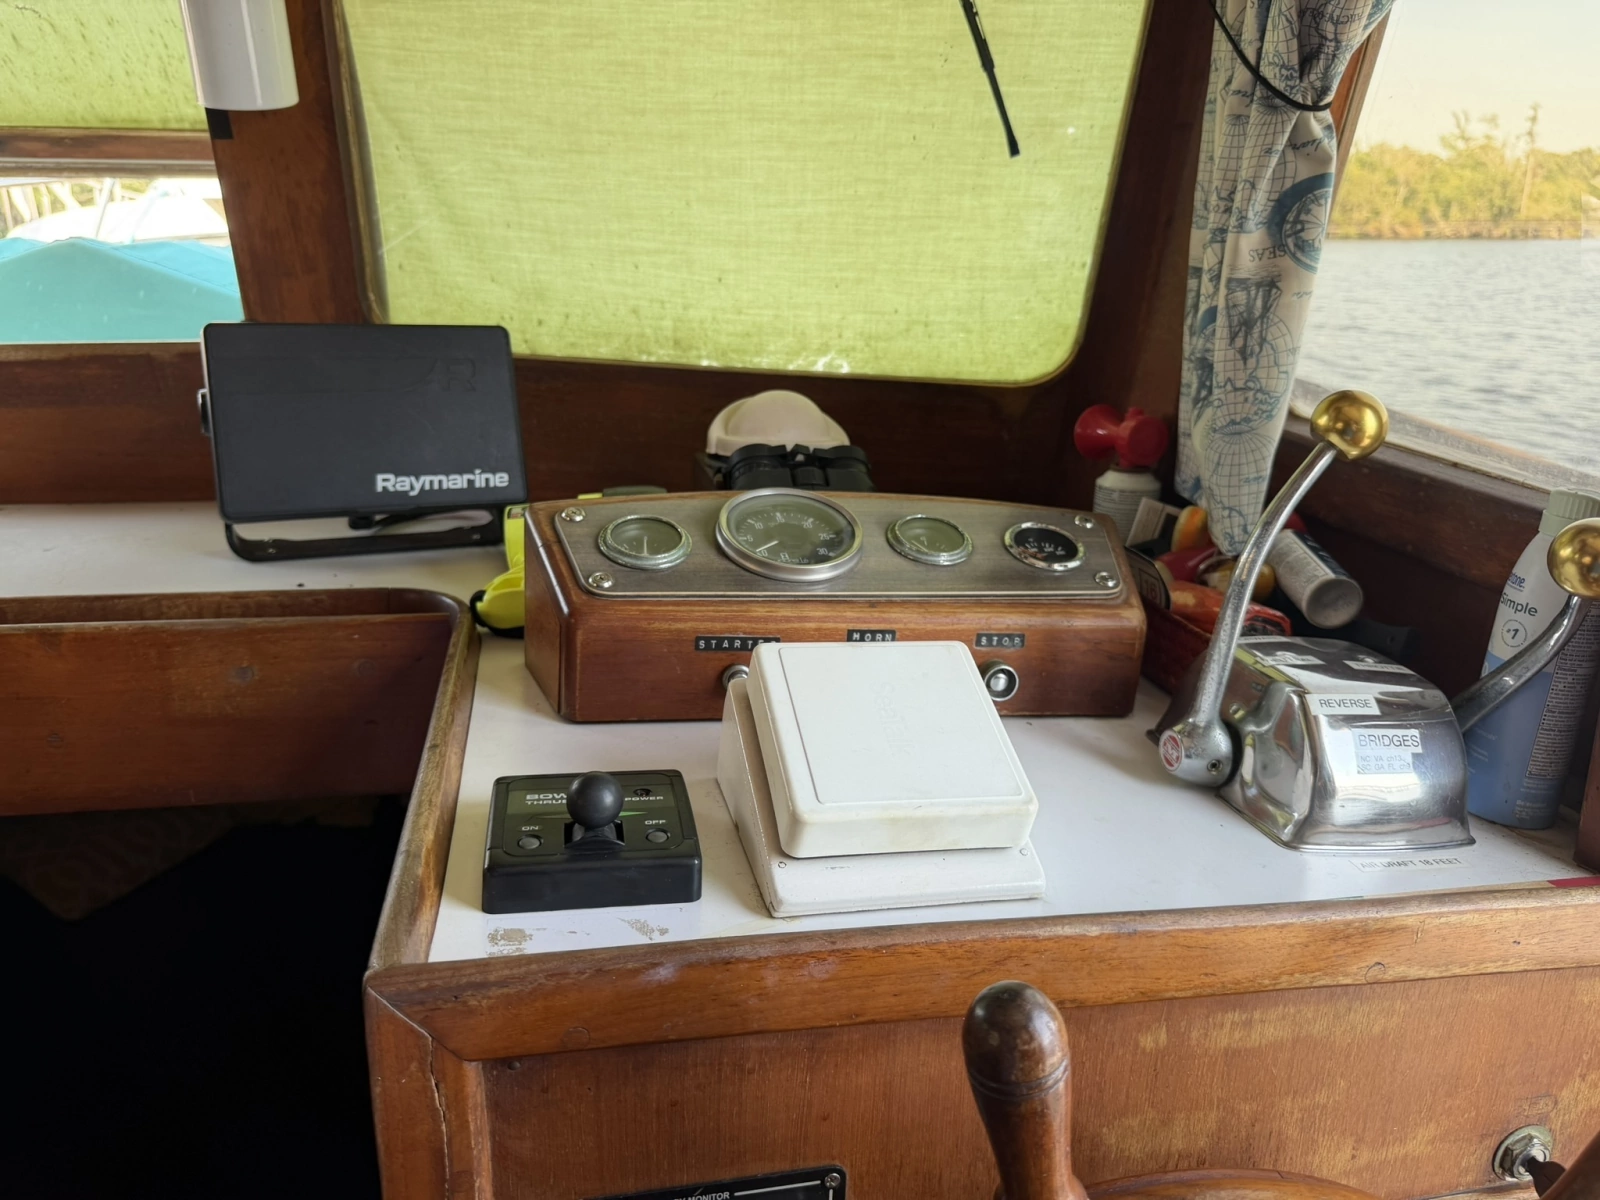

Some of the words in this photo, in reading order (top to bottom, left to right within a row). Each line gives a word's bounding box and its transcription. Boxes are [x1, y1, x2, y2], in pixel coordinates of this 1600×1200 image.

[1248, 244, 1286, 263] SEAS
[375, 469, 510, 496] Raymarine
[803, 521, 813, 529] 20
[1501, 592, 1538, 617] Simple
[853, 632, 893, 642] HORN
[980, 636, 1022, 646] STOP
[698, 639, 776, 649] START
[1319, 698, 1373, 709] REVERSE
[1358, 734, 1420, 748] BRIDGES
[526, 792, 567, 800] BOW
[1432, 857, 1462, 865] FEET
